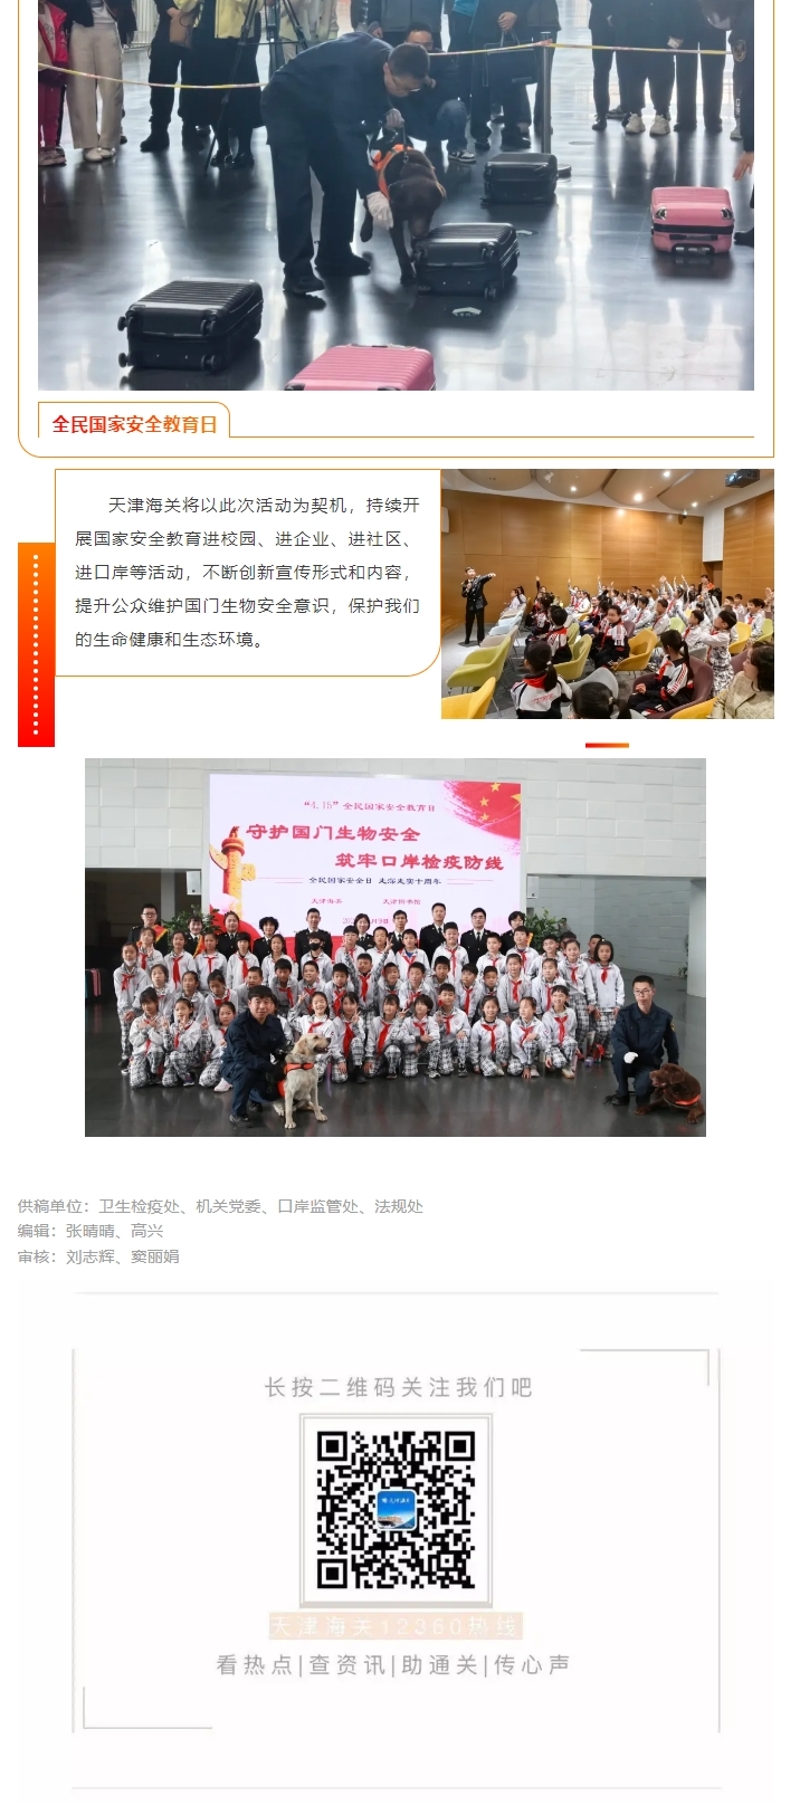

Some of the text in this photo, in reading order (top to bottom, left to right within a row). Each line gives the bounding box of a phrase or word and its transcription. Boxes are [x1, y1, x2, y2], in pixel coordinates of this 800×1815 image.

[52, 414, 217, 434] 全民国家安全教育日
[108, 496, 420, 515] 天津海关将以此次活动为契机，持续开
[75, 530, 411, 548] 展国家安全教育进校园、进企业、进社区、
[75, 563, 411, 582] 进口岸等活动，不断创新宣传形式和内容，
[75, 597, 420, 615] 提升公众维护国门生物安全意识，保护我们
[75, 631, 262, 649] 的生命健康和生态环境。
[343, 802, 436, 812] 全民国家安全教育日
[246, 824, 421, 842] 守护国门生物安全
[335, 852, 504, 871] 筑牢口岸检疫防线
[308, 876, 373, 885] 全民国家安全日
[17, 1198, 424, 1216] 供稿单位：卫生检疫处、机关党委、口岸监管处、法规处
[17, 1223, 164, 1240] 编辑：张晴晴、高兴
[17, 1249, 180, 1266] 审核：刘志辉、窦丽娟
[264, 1376, 533, 1398] 长按二维码关注我们吧
[270, 1616, 518, 1637] 天津海关12360热线
